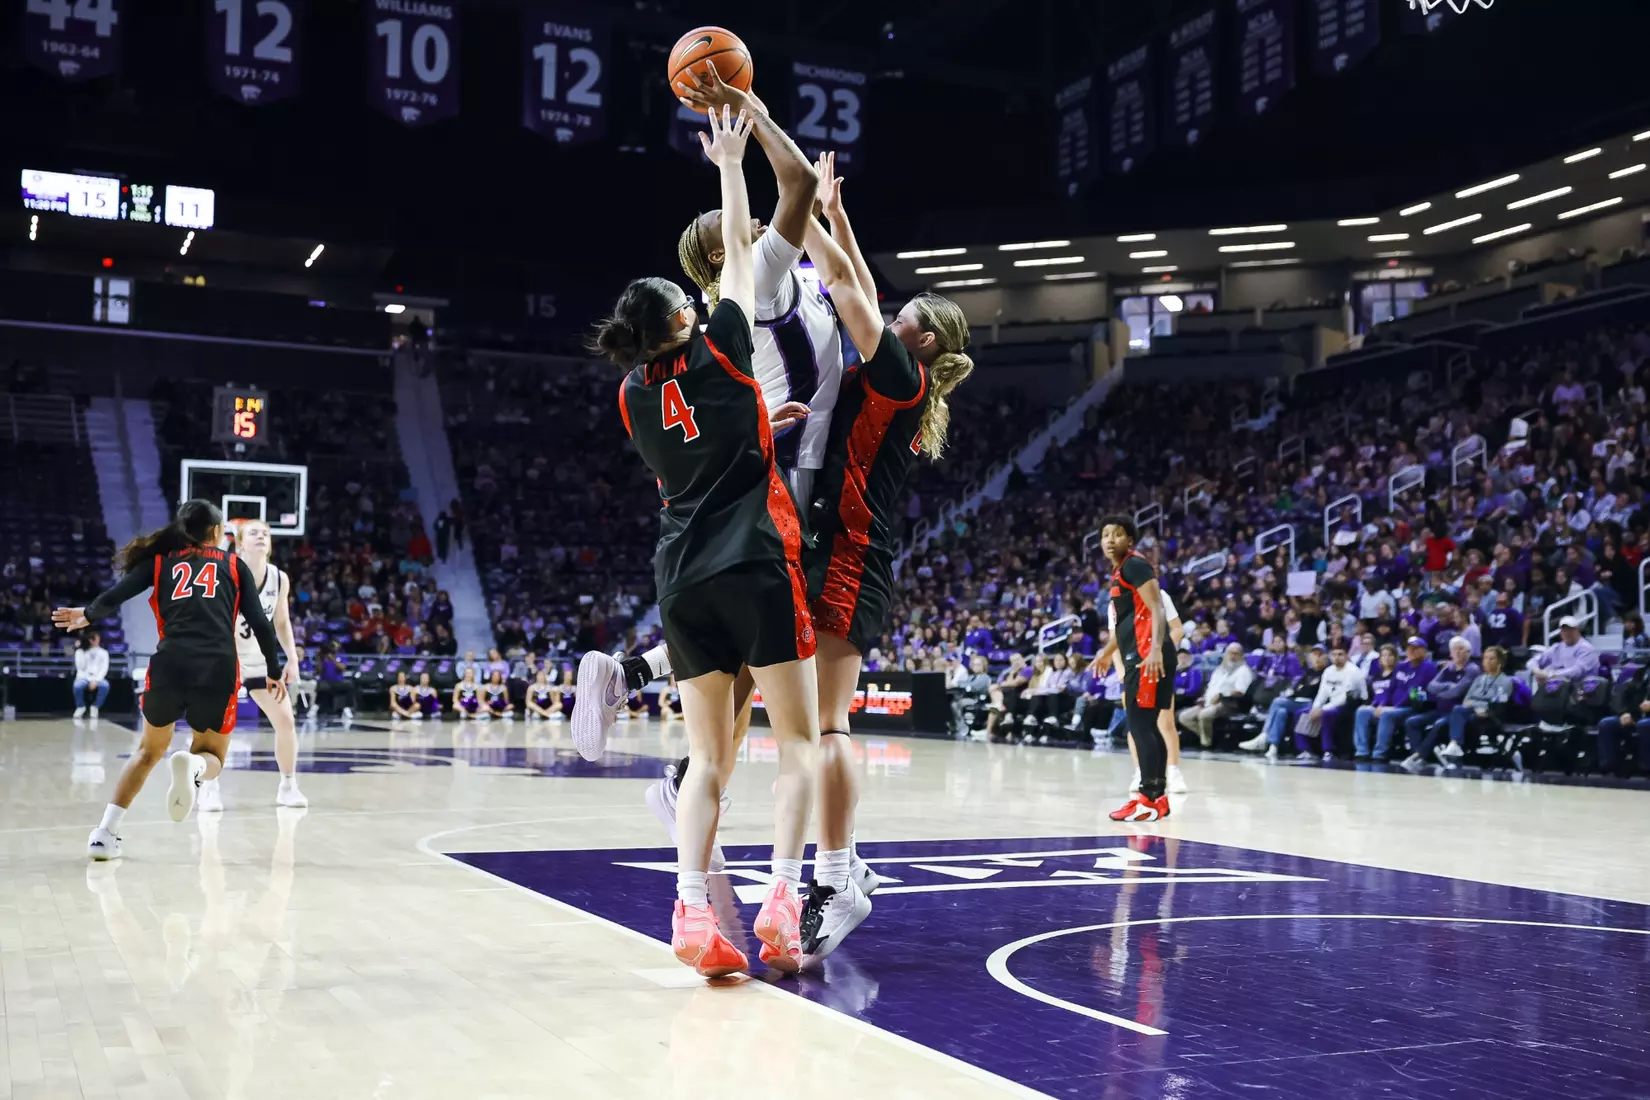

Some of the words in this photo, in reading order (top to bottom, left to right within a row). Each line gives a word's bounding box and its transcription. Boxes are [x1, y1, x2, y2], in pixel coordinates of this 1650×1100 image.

[375, 0, 453, 20] WILLIAMS
[214, 0, 293, 64] 12
[543, 21, 593, 43] EVANS
[375, 18, 450, 84] 10
[532, 42, 602, 108] 12
[793, 61, 867, 86] RICHMOND
[796, 82, 862, 144] 23
[82, 191, 107, 209] 15
[178, 200, 200, 218] 11
[525, 293, 557, 319] 15
[661, 378, 701, 443] 4
[233, 411, 256, 438] 15
[171, 561, 220, 601] 24
[239, 620, 252, 640] 3
